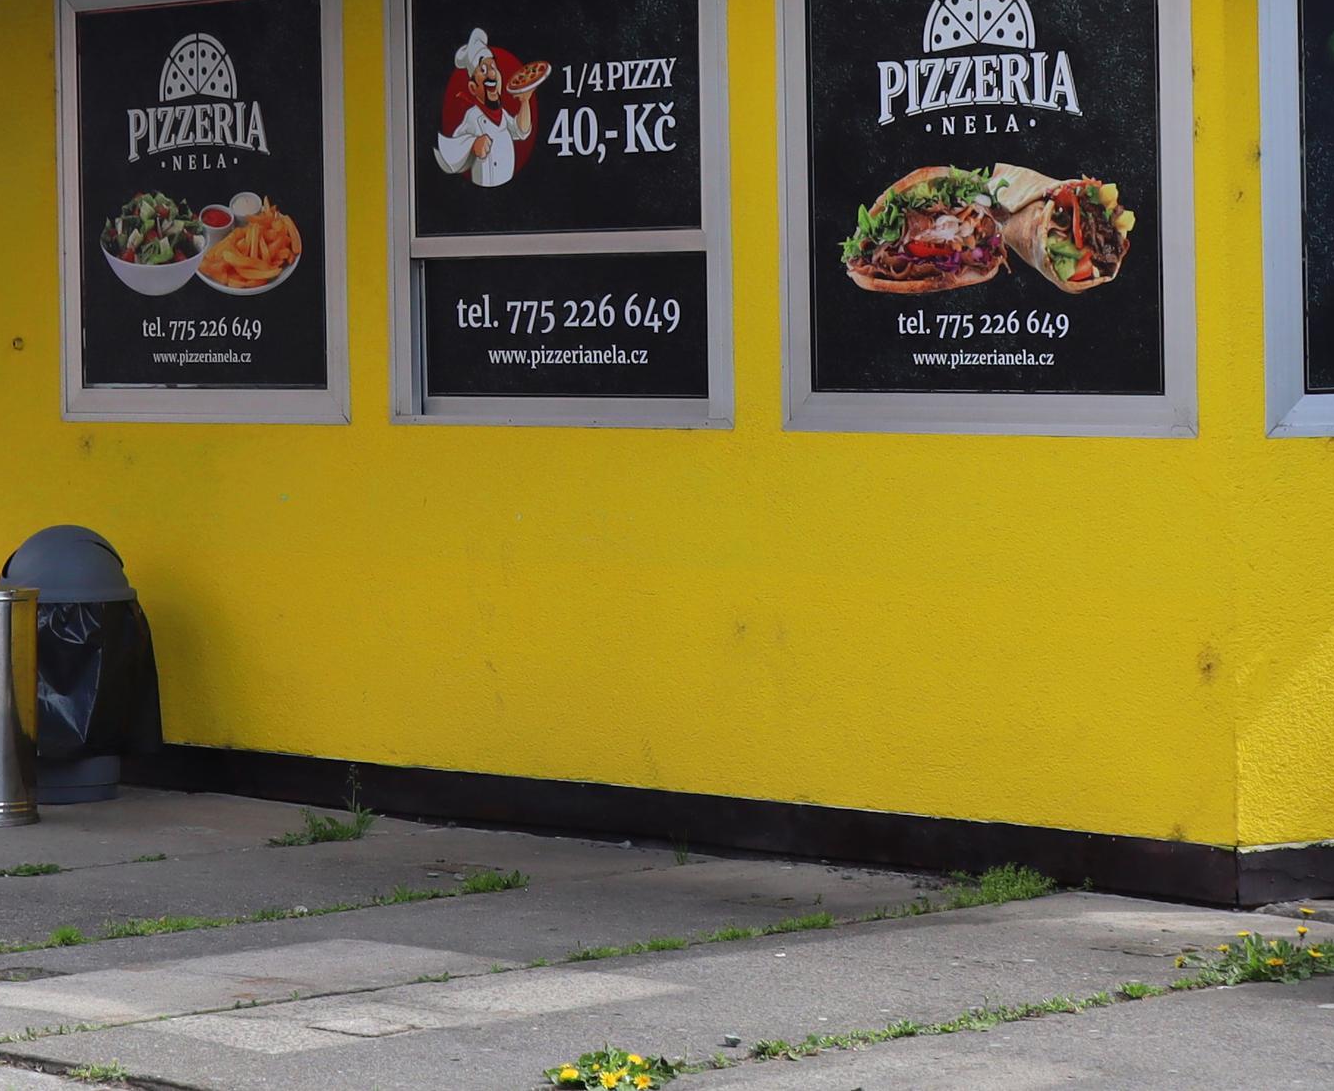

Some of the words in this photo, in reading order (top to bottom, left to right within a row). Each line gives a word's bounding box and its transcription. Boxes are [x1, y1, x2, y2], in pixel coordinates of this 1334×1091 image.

[562, 62, 604, 98] 1/4
[607, 57, 677, 91] PIZZY
[876, 50, 1083, 126] PIZZERIA
[127, 100, 271, 163] PIZZERIA
[547, 106, 619, 164] 40,-
[623, 100, 677, 154] Kč
[942, 114, 1020, 135] NELA
[172, 153, 228, 171] NELA
[456, 294, 500, 329] tel.
[506, 300, 556, 335] 775
[563, 293, 616, 328] 226
[623, 292, 681, 334] 649
[897, 309, 931, 335] tel.
[936, 314, 974, 339] 775
[979, 309, 1020, 334] 226
[1026, 310, 1070, 338] 649
[142, 317, 166, 338] tel.
[168, 321, 197, 341] 775
[199, 317, 228, 338] 226
[231, 317, 262, 341] 649
[152, 348, 252, 366] www.pizzerianela.cz
[488, 344, 649, 369] www.pizzerianela.cz
[912, 349, 1055, 369] www.pizzerianela.cz
